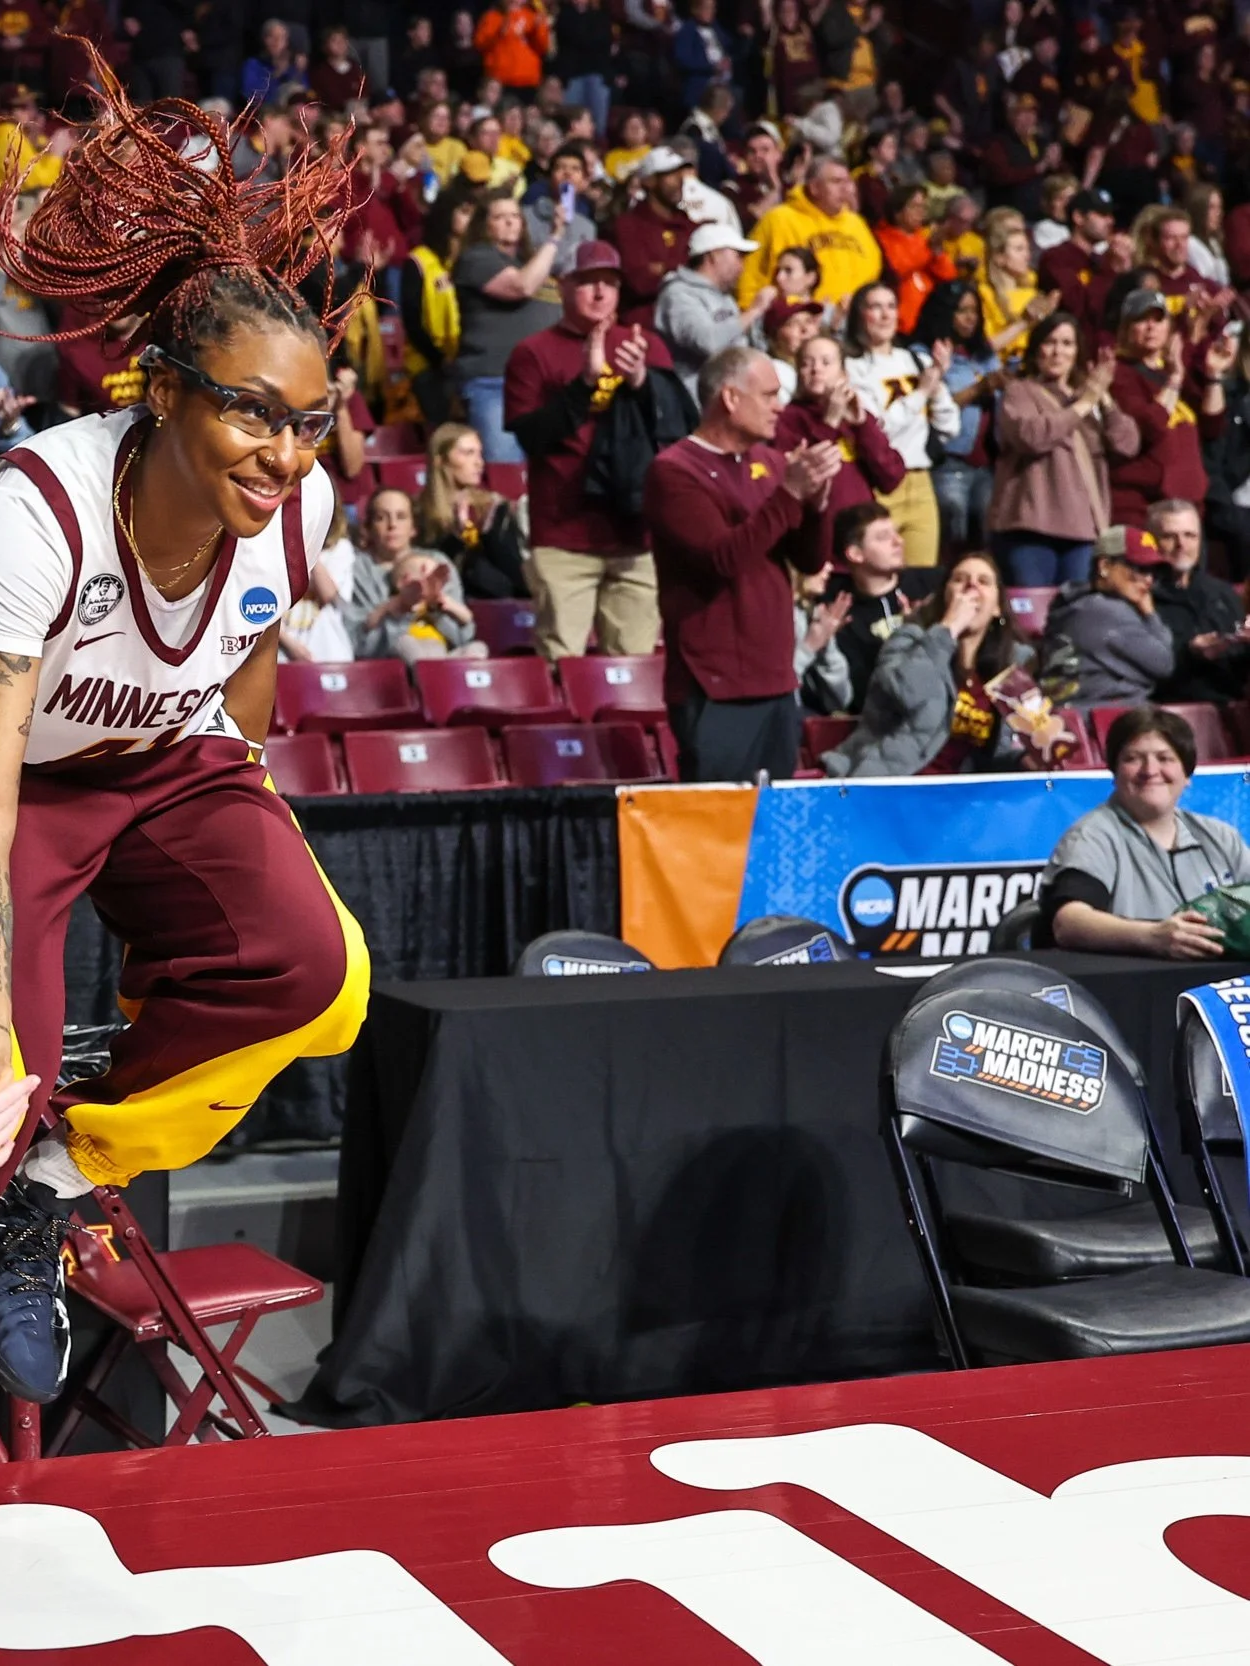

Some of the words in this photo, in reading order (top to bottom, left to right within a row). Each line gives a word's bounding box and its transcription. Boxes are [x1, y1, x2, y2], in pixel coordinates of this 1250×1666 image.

[245, 603, 277, 615] NCAA
[972, 1022, 1062, 1067] MARCH
[982, 1050, 1101, 1104] MADNESS
